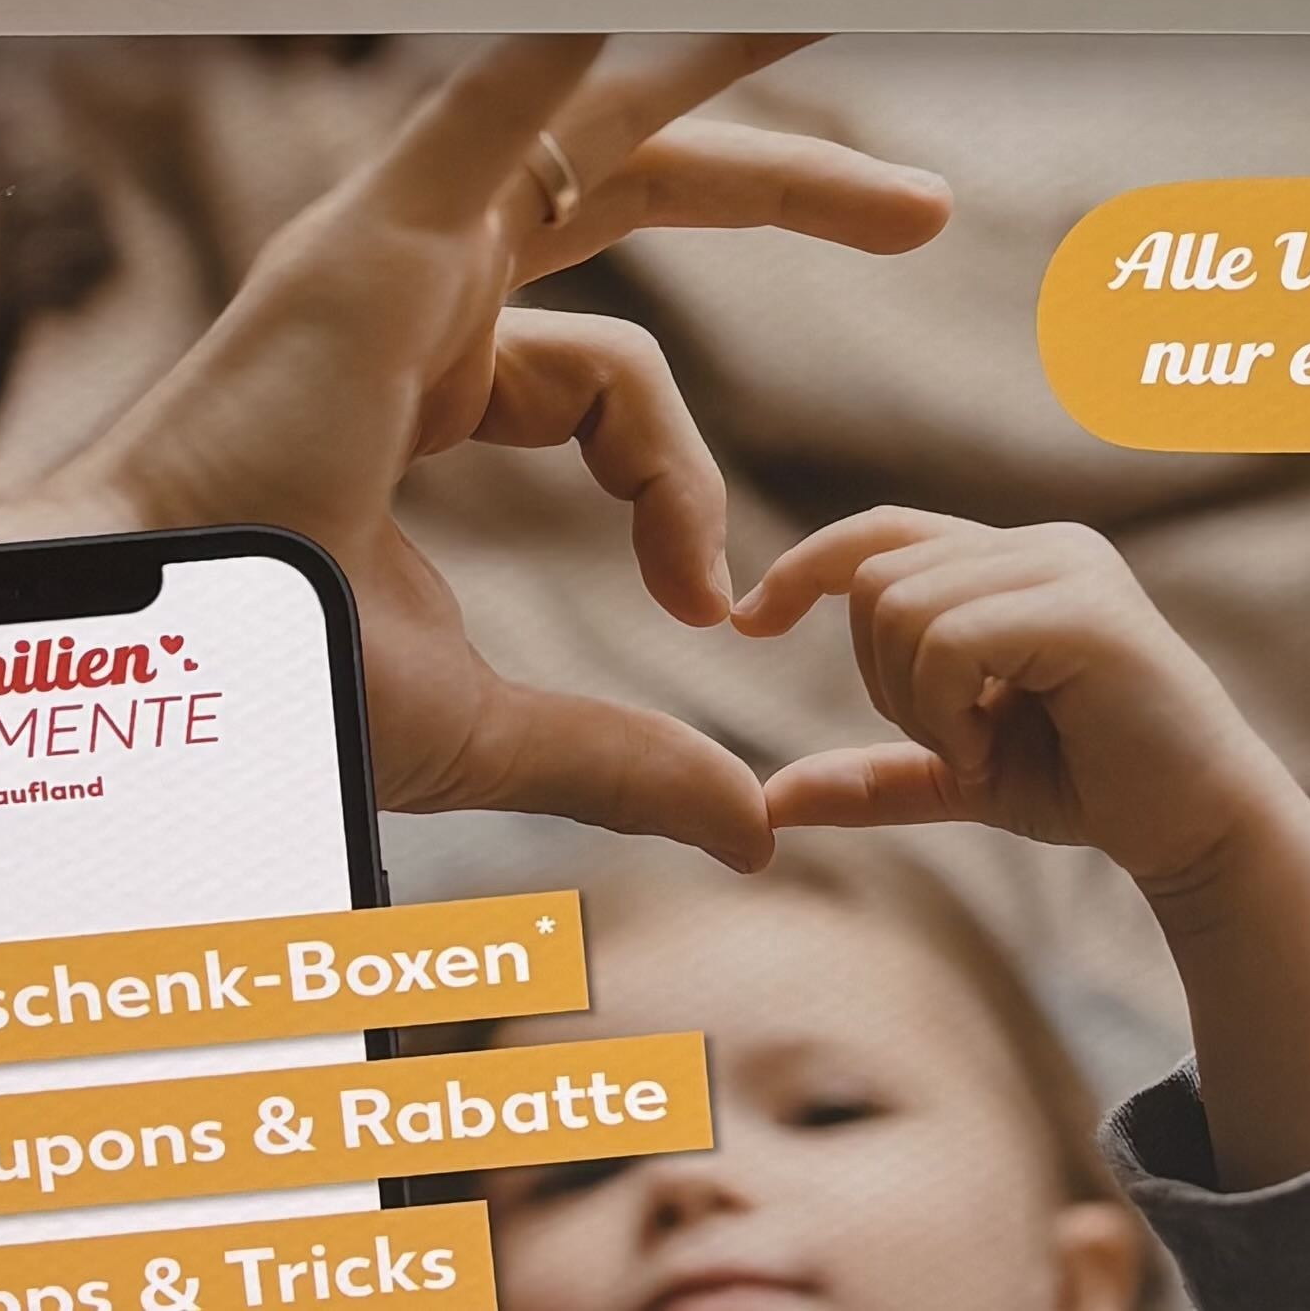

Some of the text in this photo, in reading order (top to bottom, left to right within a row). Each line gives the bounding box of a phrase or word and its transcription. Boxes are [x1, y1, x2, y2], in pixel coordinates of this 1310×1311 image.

[1107, 230, 1257, 291] Alle
[1139, 338, 1275, 386] nur
[252, 1093, 315, 1155] &
[340, 1069, 669, 1154] Rabatte
[140, 1257, 202, 1311] &
[224, 1235, 457, 1308] Tricks
